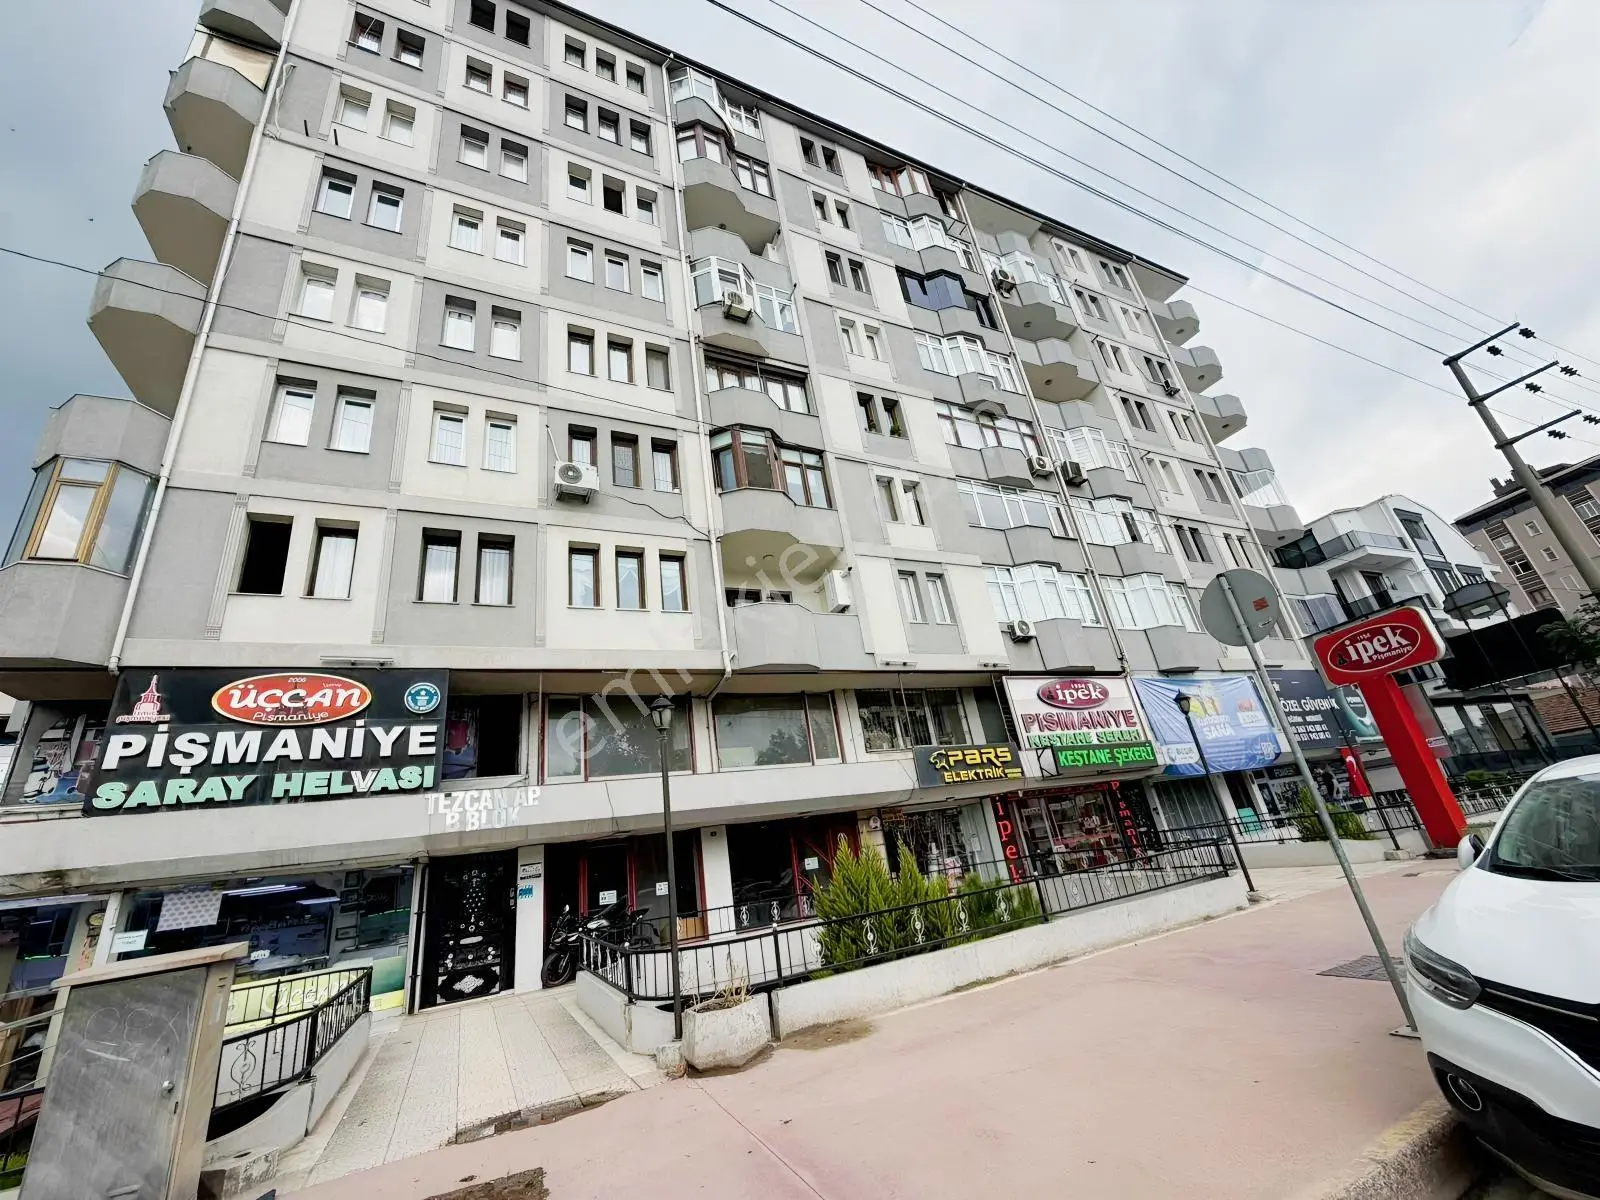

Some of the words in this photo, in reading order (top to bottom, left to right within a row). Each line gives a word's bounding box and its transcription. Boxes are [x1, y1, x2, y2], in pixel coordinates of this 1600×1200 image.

[1344, 626, 1411, 664] ipek
[1055, 684, 1105, 704] ipek
[253, 710, 329, 722] Pişmaniye
[101, 719, 438, 775] PİŞMANİYE
[1114, 744, 1155, 767] ŞEKERİ
[944, 766, 1006, 783] ELEKTRİK
[92, 774, 258, 809] SARAY
[271, 765, 435, 798] HELVASI
[424, 787, 508, 814] TEZCAN
[465, 808, 520, 832] BLOK
